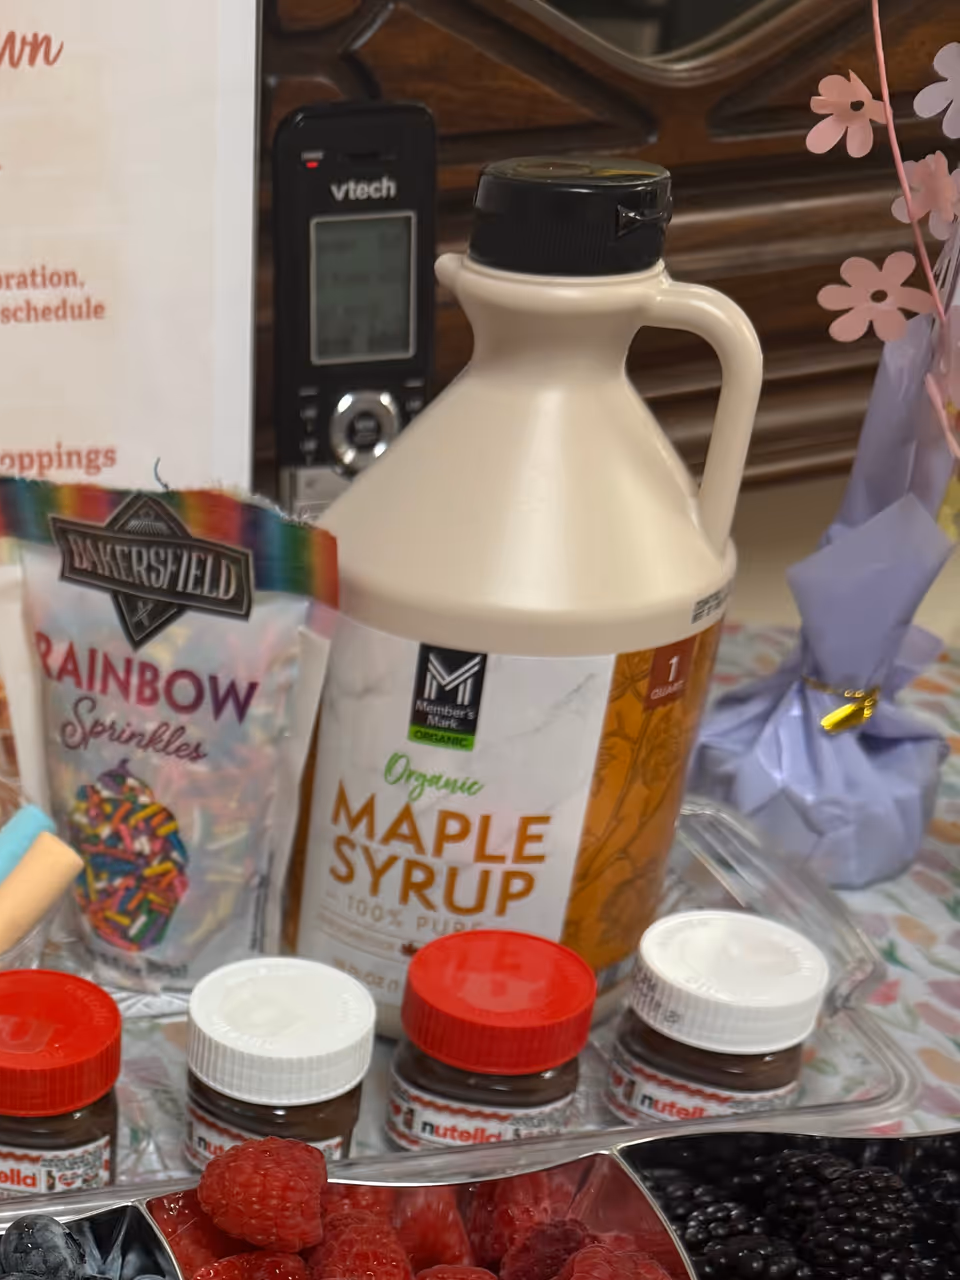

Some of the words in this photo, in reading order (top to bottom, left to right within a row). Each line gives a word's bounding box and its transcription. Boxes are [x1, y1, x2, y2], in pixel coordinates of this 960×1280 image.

[330, 176, 396, 200] vtech
[0, 297, 106, 325] schedule
[67, 534, 237, 600] BAKERSFIELD
[35, 631, 260, 726] RAINBOW
[669, 655, 680, 682] 1
[60, 696, 207, 762] Sprinkles
[415, 700, 474, 720] Member's
[414, 730, 468, 747] ORGANIC
[384, 752, 485, 801] Organic
[331, 778, 552, 864] MAPLE
[329, 835, 535, 917] SYRUP
[346, 895, 403, 928] 100%
